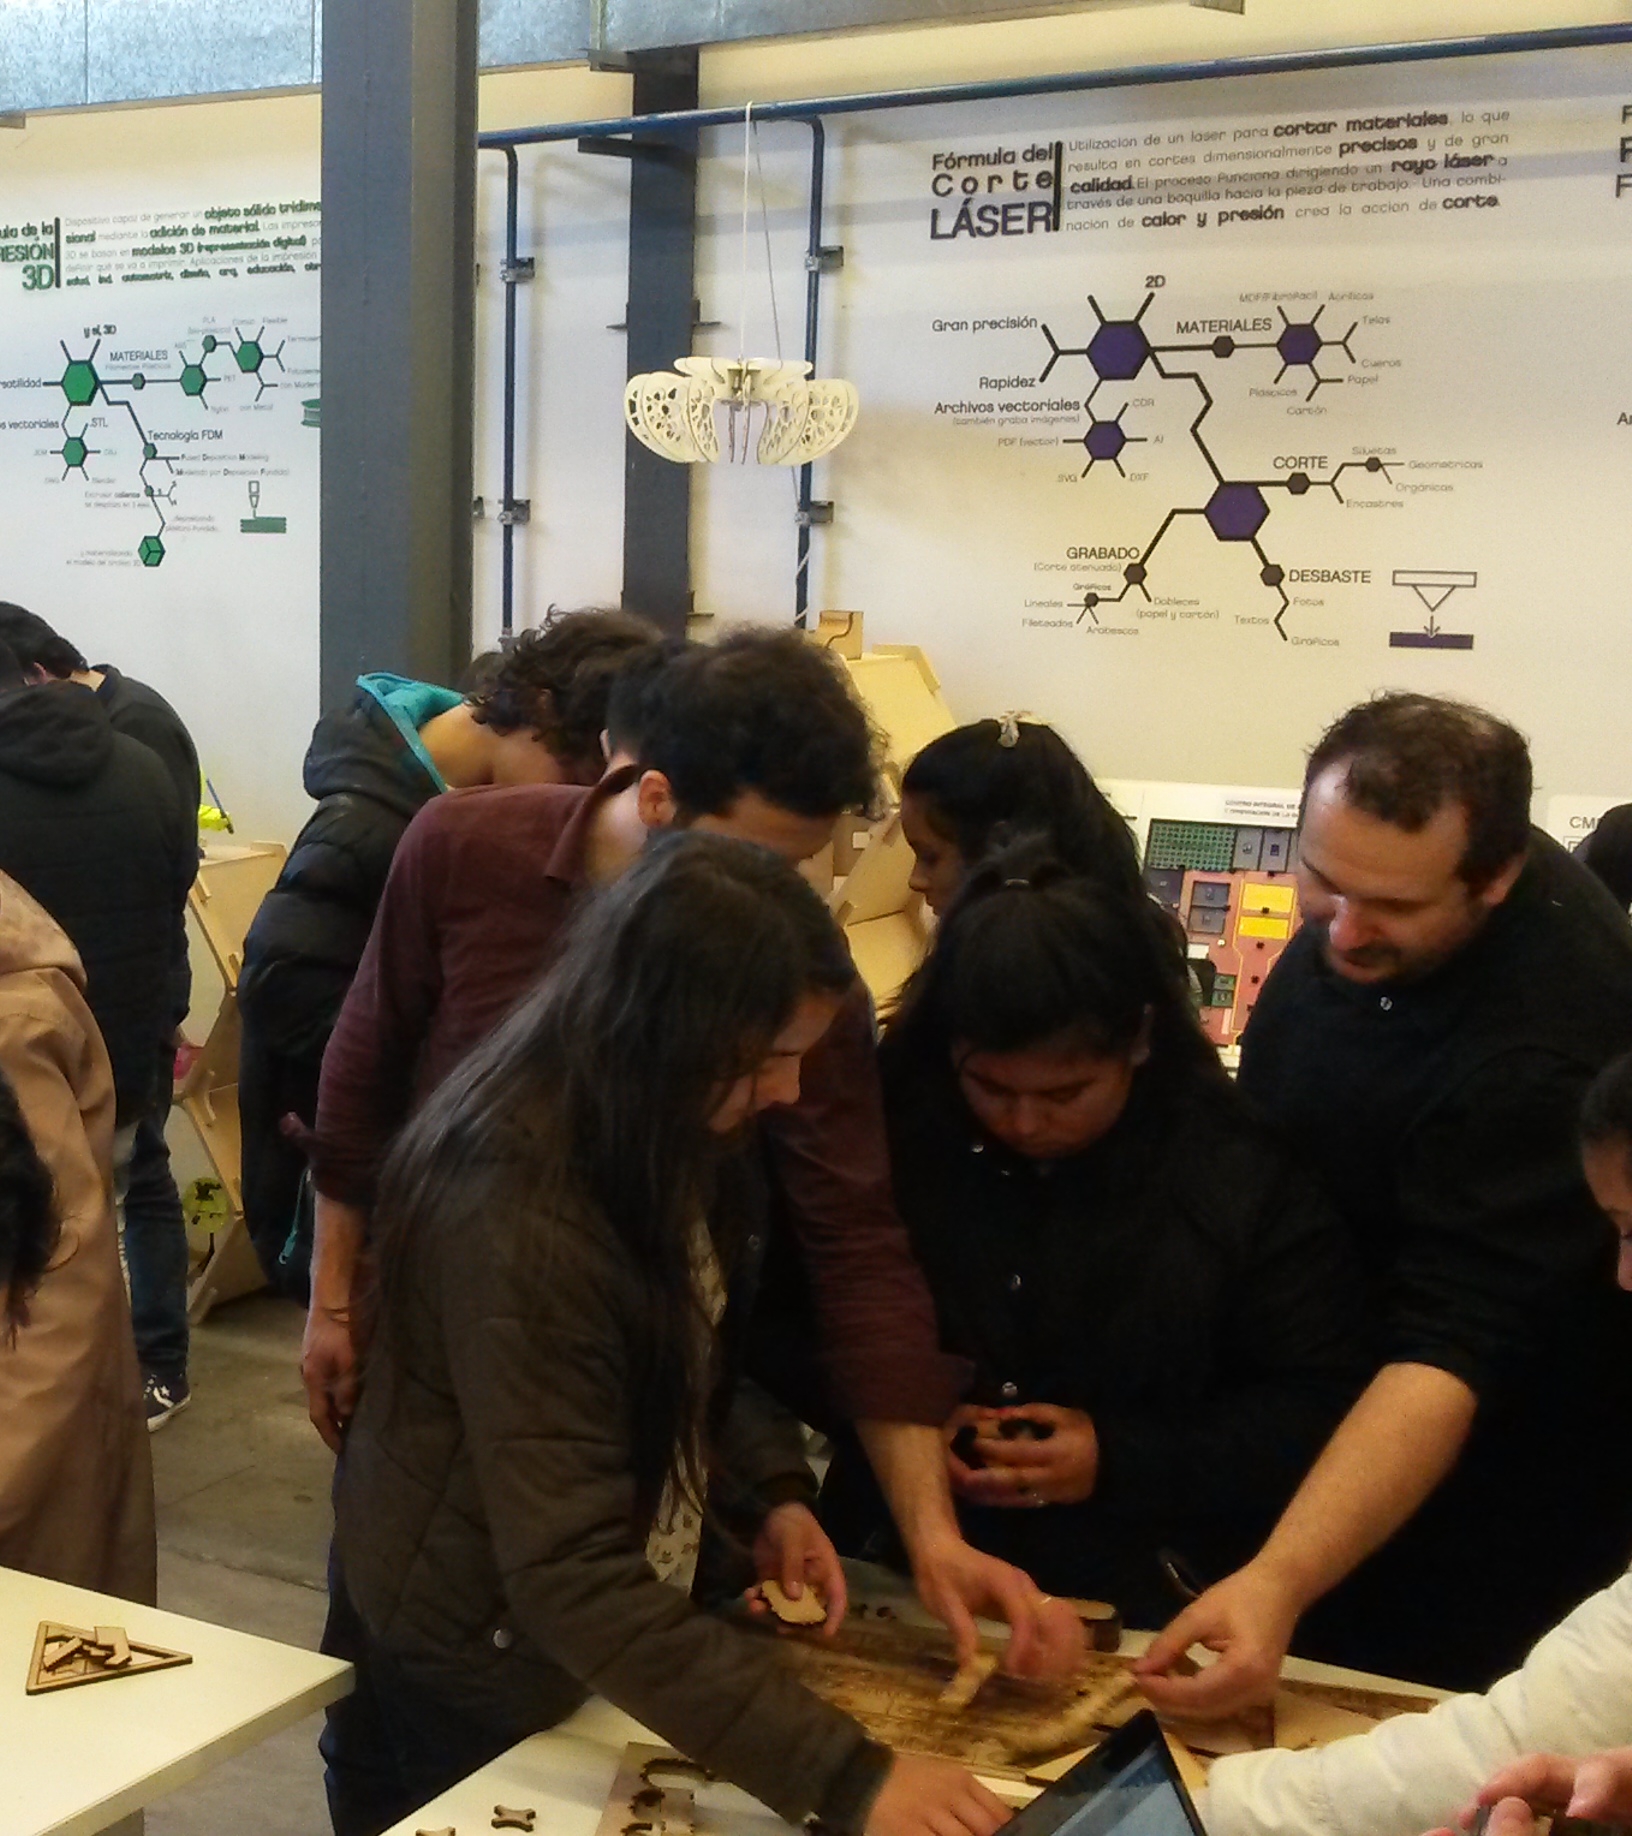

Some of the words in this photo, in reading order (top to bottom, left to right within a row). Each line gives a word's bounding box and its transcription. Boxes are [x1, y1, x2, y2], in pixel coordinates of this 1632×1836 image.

[1144, 134, 1160, 147] de
[1168, 132, 1184, 144] un
[1233, 127, 1268, 142] para
[1273, 120, 1338, 138] cortar
[1462, 111, 1474, 123] lo
[1481, 109, 1510, 126] que
[932, 146, 1016, 171] Fórmula
[1022, 142, 1054, 163] del
[1068, 160, 1117, 174] resulta
[1125, 158, 1141, 169] en
[1149, 154, 1196, 167] cortes
[1203, 144, 1332, 164] dimensionalmente
[1339, 136, 1419, 158] precisos
[1428, 138, 1436, 152] y
[1445, 134, 1463, 147] de
[1472, 133, 1509, 148] gran
[1137, 178, 1149, 189] El
[1154, 175, 1211, 191] proceso
[1217, 168, 1280, 184] funciona
[1286, 163, 1358, 182] dirigiendo
[1366, 164, 1382, 175] un
[1391, 156, 1438, 176] rayo
[1444, 153, 1494, 168] láser
[1498, 157, 1507, 166] a
[931, 169, 1054, 198] Corte
[1067, 197, 1112, 210] través
[1116, 194, 1132, 207] de
[1137, 195, 1162, 206] una
[1167, 190, 1221, 206] boquilla
[1225, 186, 1263, 200] hacia
[1269, 185, 1281, 197] la
[1286, 182, 1323, 198] pieza
[1328, 181, 1346, 194] de
[1422, 175, 1451, 189] Una
[204, 205, 241, 222] objeto
[243, 203, 276, 217] sólido
[930, 197, 1052, 240] LÁSER
[1118, 216, 1134, 229] de
[1141, 210, 1187, 228] calor
[1197, 211, 1208, 228] y
[1218, 205, 1285, 226] presión
[1295, 205, 1329, 219] crea
[1339, 203, 1351, 216] la
[1419, 198, 1437, 211] de
[21, 222, 38, 237] de
[41, 221, 54, 236] la
[66, 230, 96, 244] sional
[149, 224, 188, 239] adición
[191, 222, 206, 237] de
[132, 243, 176, 256] modelos
[179, 241, 195, 255] 3D
[22, 264, 55, 291] 3D
[1145, 275, 1166, 288] 2D
[932, 319, 968, 333] Gran
[973, 315, 1038, 334] precisión
[1176, 318, 1273, 335] MATERIALES
[110, 350, 169, 362] MATERIALES
[979, 376, 1036, 392] Rapidez
[1348, 373, 1379, 387] Papel
[934, 400, 994, 415] Archivos
[998, 397, 1080, 413] vectoriales
[9, 418, 60, 430] vectoriales
[148, 429, 199, 443] Tecnología
[202, 429, 223, 440] FDM
[1273, 456, 1328, 469] CORTE
[1066, 546, 1140, 560] GRABADO
[1034, 562, 1067, 573] (Corte
[1070, 562, 1122, 573] atenuado)
[1288, 569, 1372, 583] DESBASTE
[1024, 598, 1064, 608] Lineales
[1293, 597, 1325, 607] Fotos
[1136, 609, 1168, 620] (papel
[1234, 614, 1270, 625] Textos
[1086, 625, 1139, 635] Arabescos
[1569, 815, 1598, 830] CM
